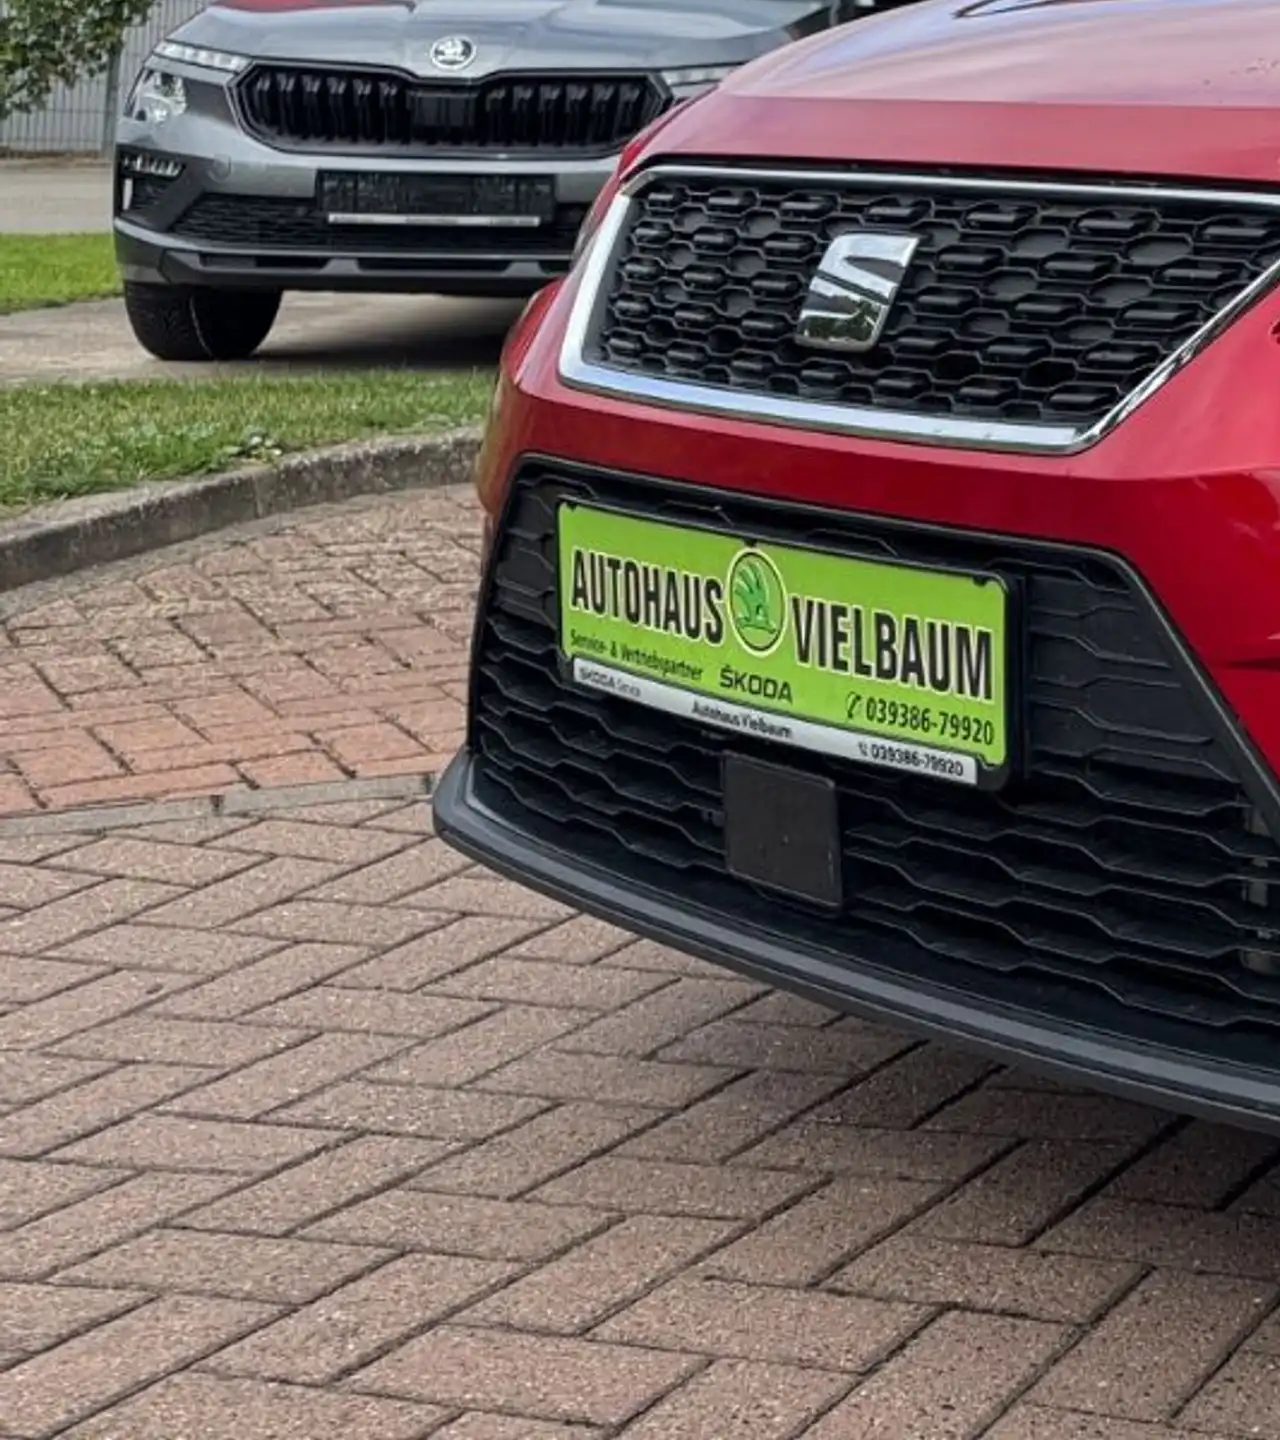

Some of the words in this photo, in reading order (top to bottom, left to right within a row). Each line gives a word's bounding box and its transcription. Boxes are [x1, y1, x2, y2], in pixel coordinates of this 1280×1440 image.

[569, 549, 725, 645] AUTOHAUS
[791, 594, 993, 700] VIELBAUM
[719, 664, 794, 704] ŠKODA
[865, 696, 995, 746] 039386-79920
